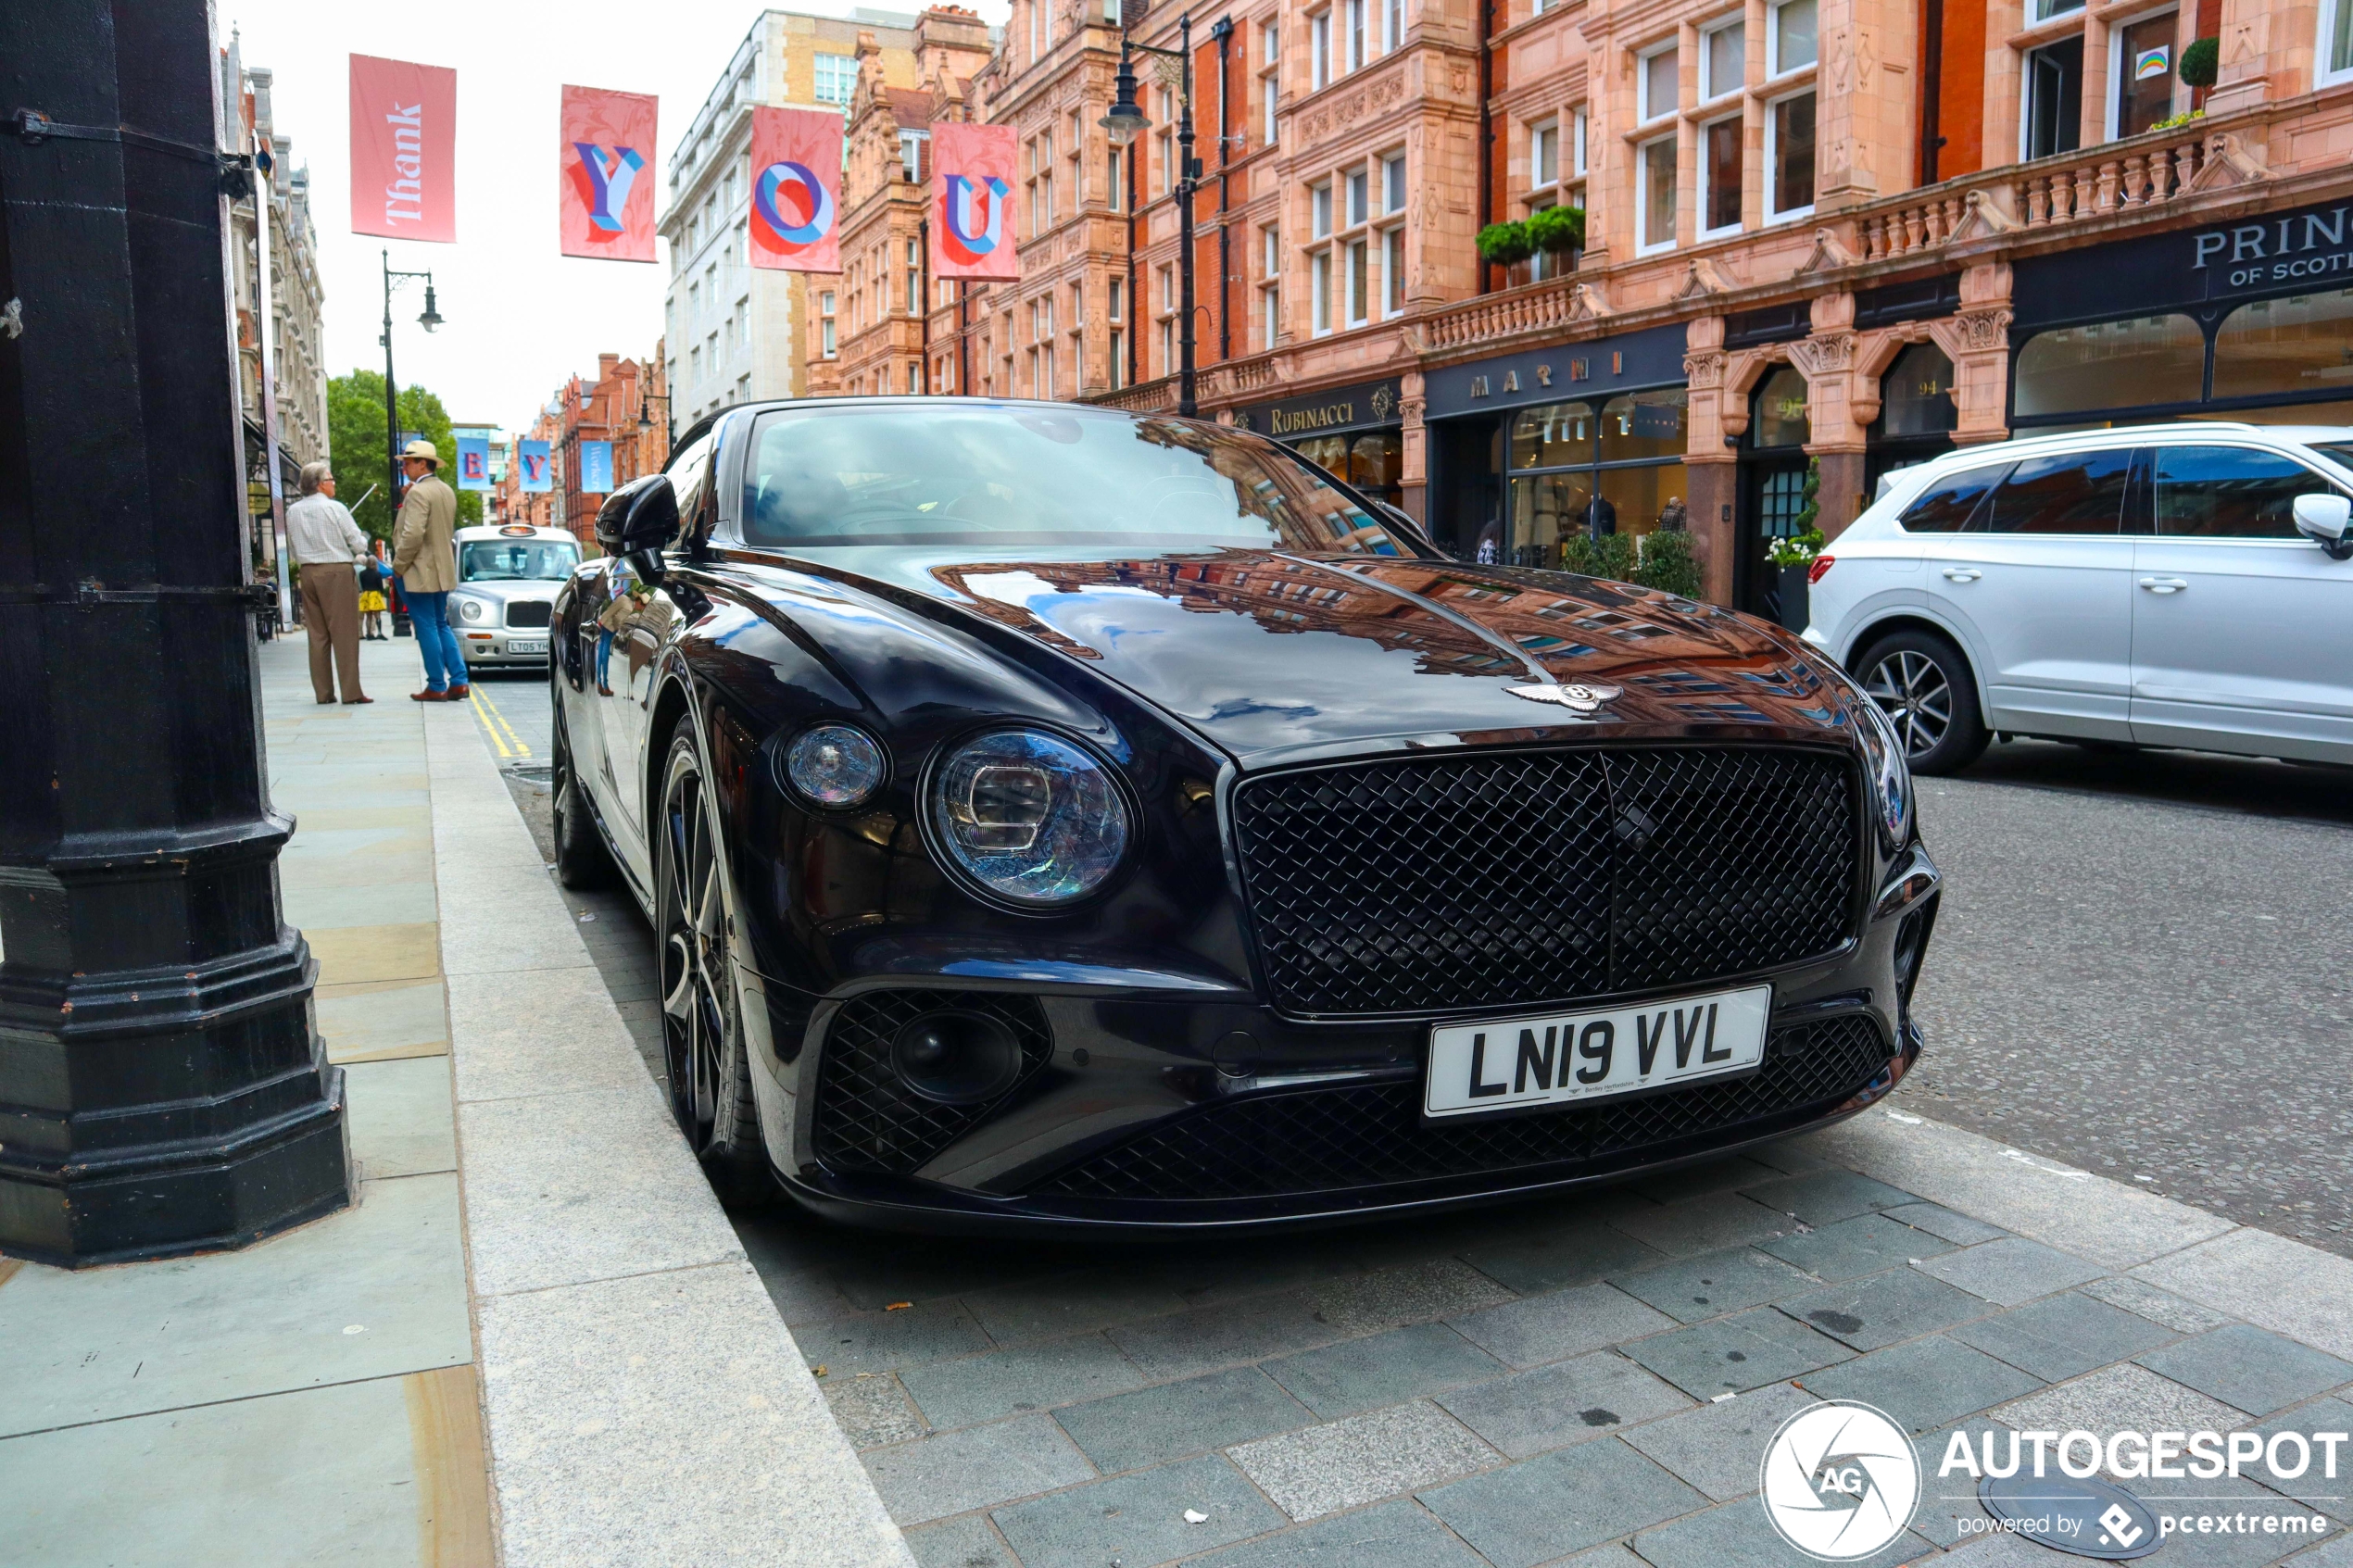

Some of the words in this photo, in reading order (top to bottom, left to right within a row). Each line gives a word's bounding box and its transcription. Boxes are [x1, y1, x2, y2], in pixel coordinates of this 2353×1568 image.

[385, 101, 422, 226] Thank
[569, 142, 646, 232] Y
[754, 160, 835, 245] O
[942, 173, 1010, 255] U
[2192, 207, 2353, 270] PRIN
[2230, 268, 2264, 286] OF
[1471, 351, 1622, 398] MARNI
[1919, 380, 1937, 395] 94
[464, 452, 484, 479] E
[523, 454, 546, 481] Y
[1468, 1019, 1615, 1098] LN19
[1636, 1003, 1732, 1076] VVL
[1585, 1085, 1603, 1094] Bentley
[1604, 1080, 1634, 1090] Hertfordshire
